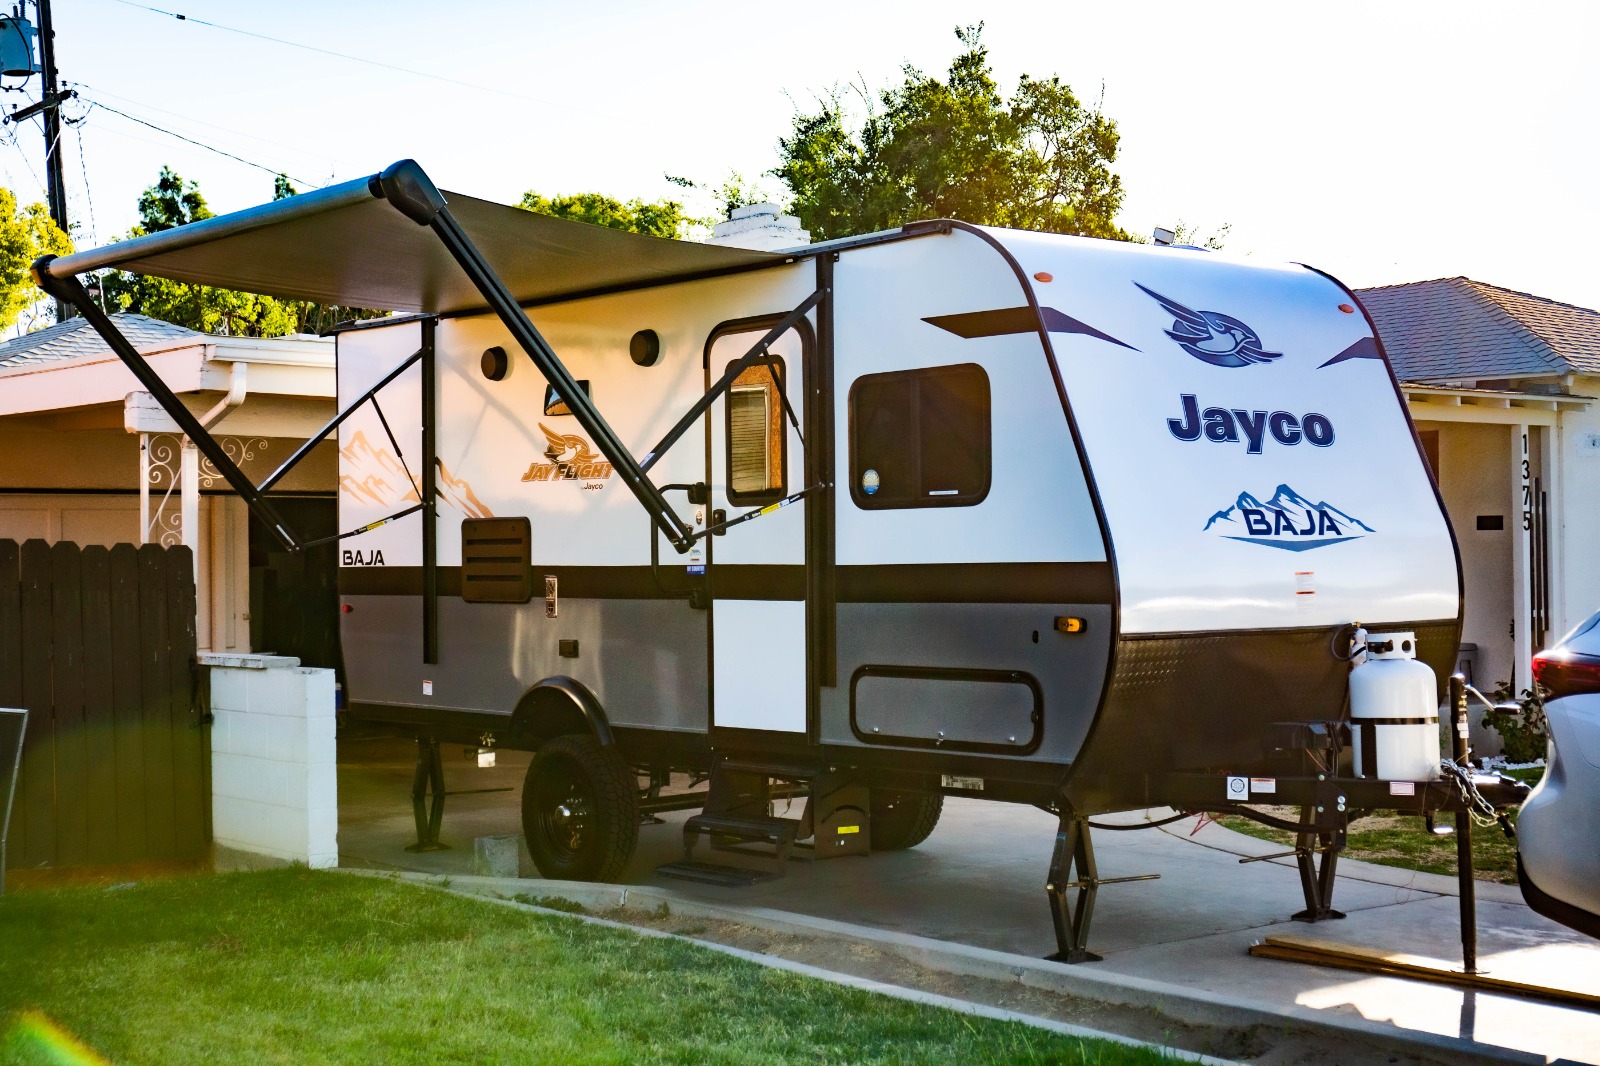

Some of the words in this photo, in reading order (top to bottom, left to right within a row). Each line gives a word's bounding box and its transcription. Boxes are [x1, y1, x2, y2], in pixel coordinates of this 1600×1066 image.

[1167, 393, 1335, 454] Jayco
[521, 463, 557, 482] JAY
[552, 461, 614, 480] FLIGHT
[1522, 434, 1531, 531] 1375
[584, 482, 604, 491] Jayco
[1241, 509, 1343, 536] BAJA
[342, 550, 385, 566] BAJA
